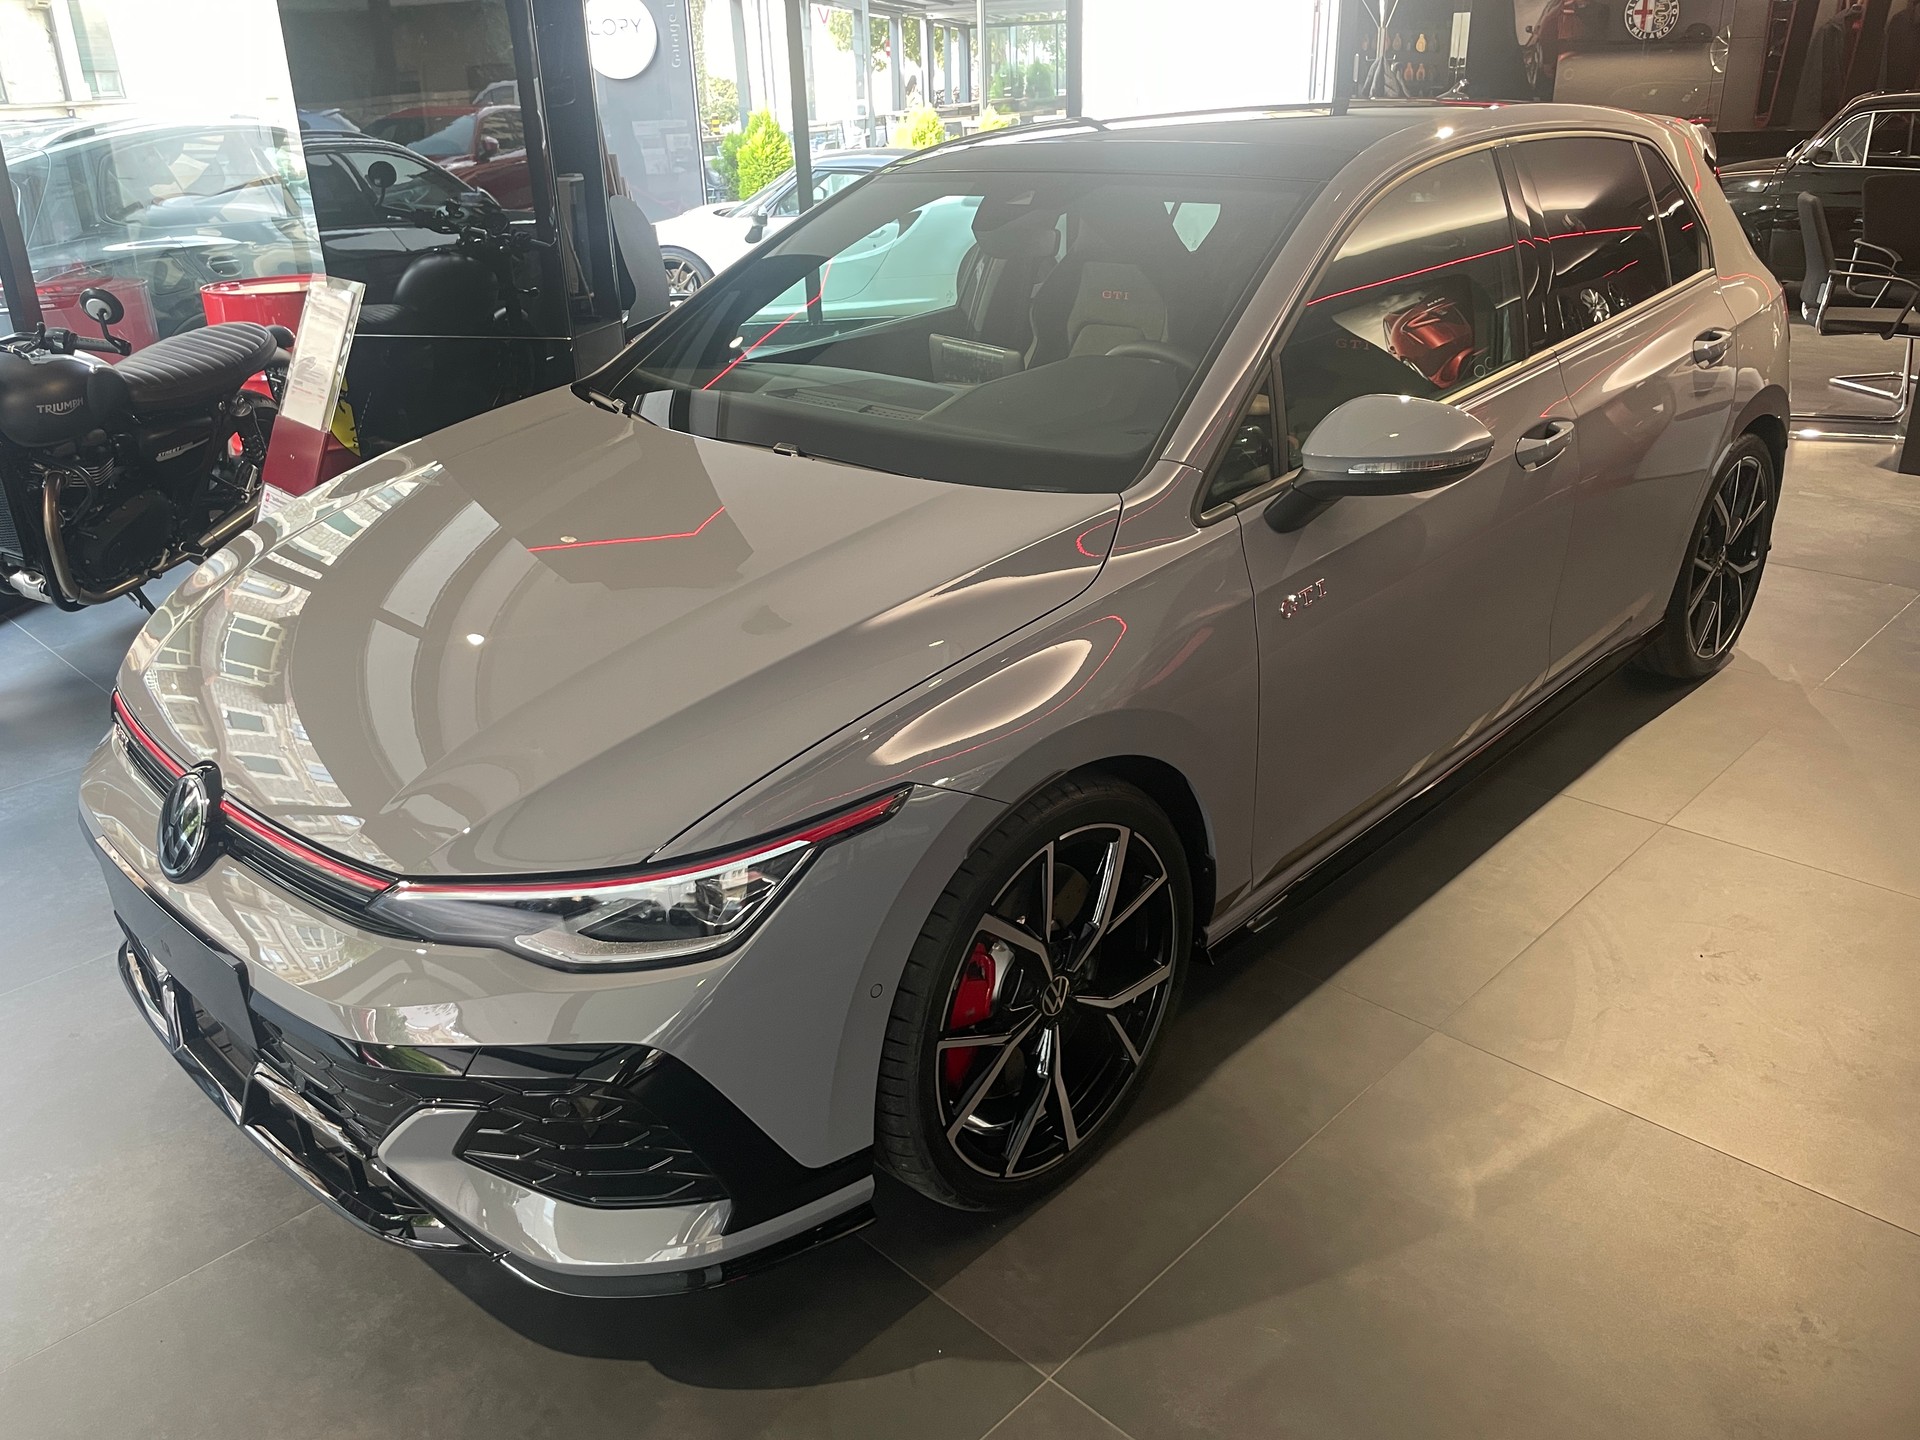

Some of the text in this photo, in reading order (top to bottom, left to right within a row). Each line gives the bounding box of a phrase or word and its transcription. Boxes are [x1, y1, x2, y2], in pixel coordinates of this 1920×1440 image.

[669, 13, 681, 68] Garage
[1631, 26, 1669, 39] MILANO
[1102, 290, 1129, 300] GTI
[36, 397, 84, 415] TRIUMPH
[1280, 578, 1327, 619] GTI
